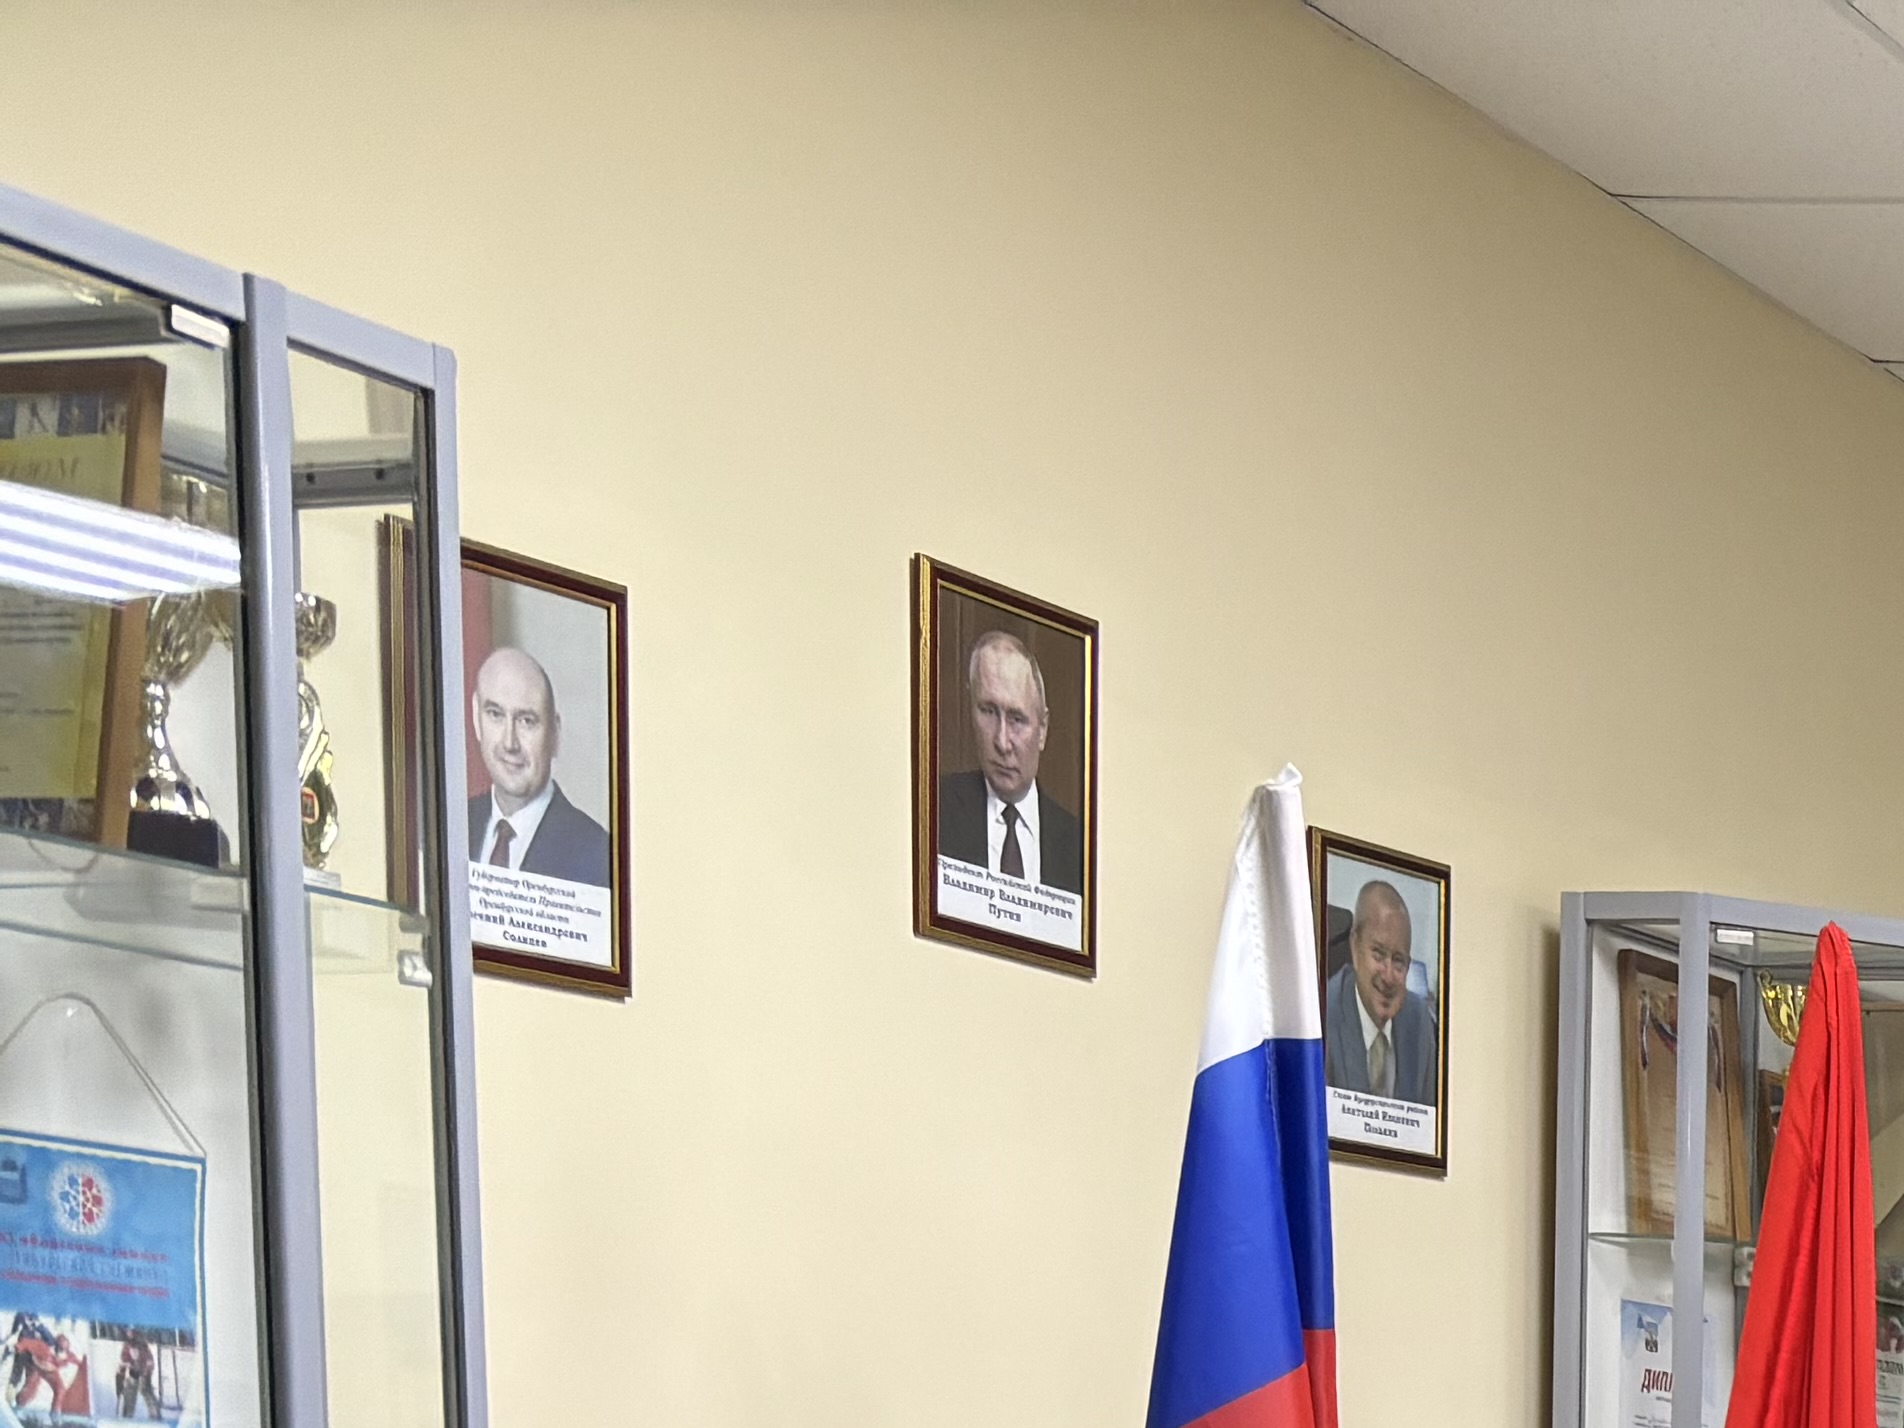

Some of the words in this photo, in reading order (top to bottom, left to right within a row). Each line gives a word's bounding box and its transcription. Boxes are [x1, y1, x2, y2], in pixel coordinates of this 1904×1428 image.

[943, 874, 995, 898] Владимир
[999, 889, 1073, 920] Владимирович
[988, 903, 1021, 922] Путин
